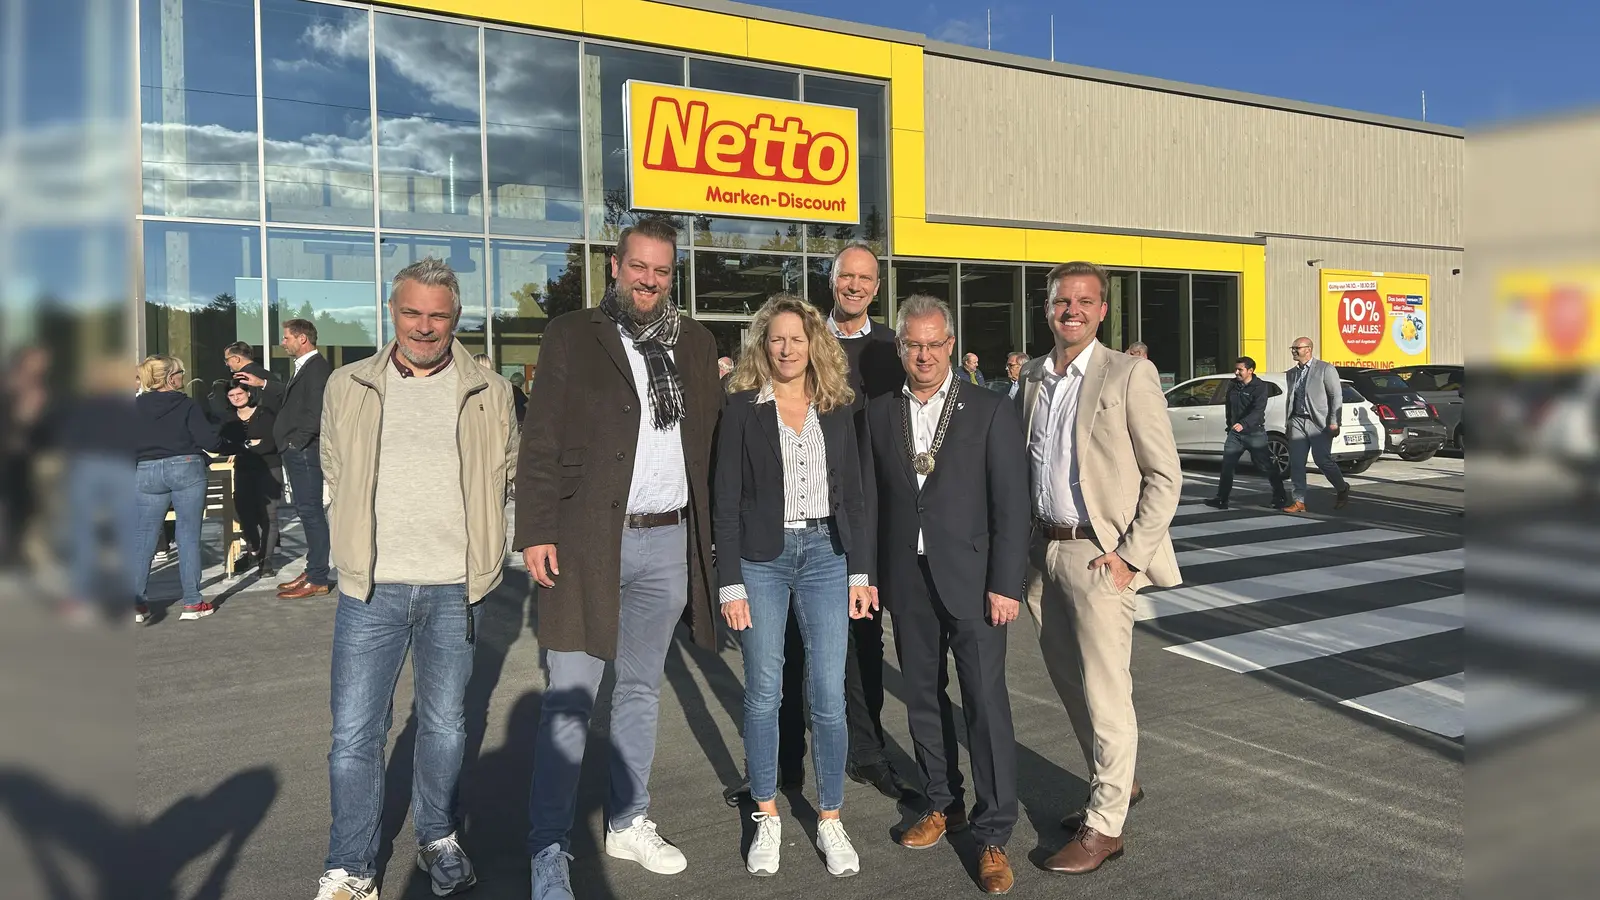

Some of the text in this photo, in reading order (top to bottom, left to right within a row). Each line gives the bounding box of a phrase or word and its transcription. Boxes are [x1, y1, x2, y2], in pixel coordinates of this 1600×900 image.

[643, 96, 849, 185] Netto
[706, 186, 846, 212] Marken-Discount
[1343, 297, 1380, 322] 10%
[1342, 324, 1357, 334] AUF
